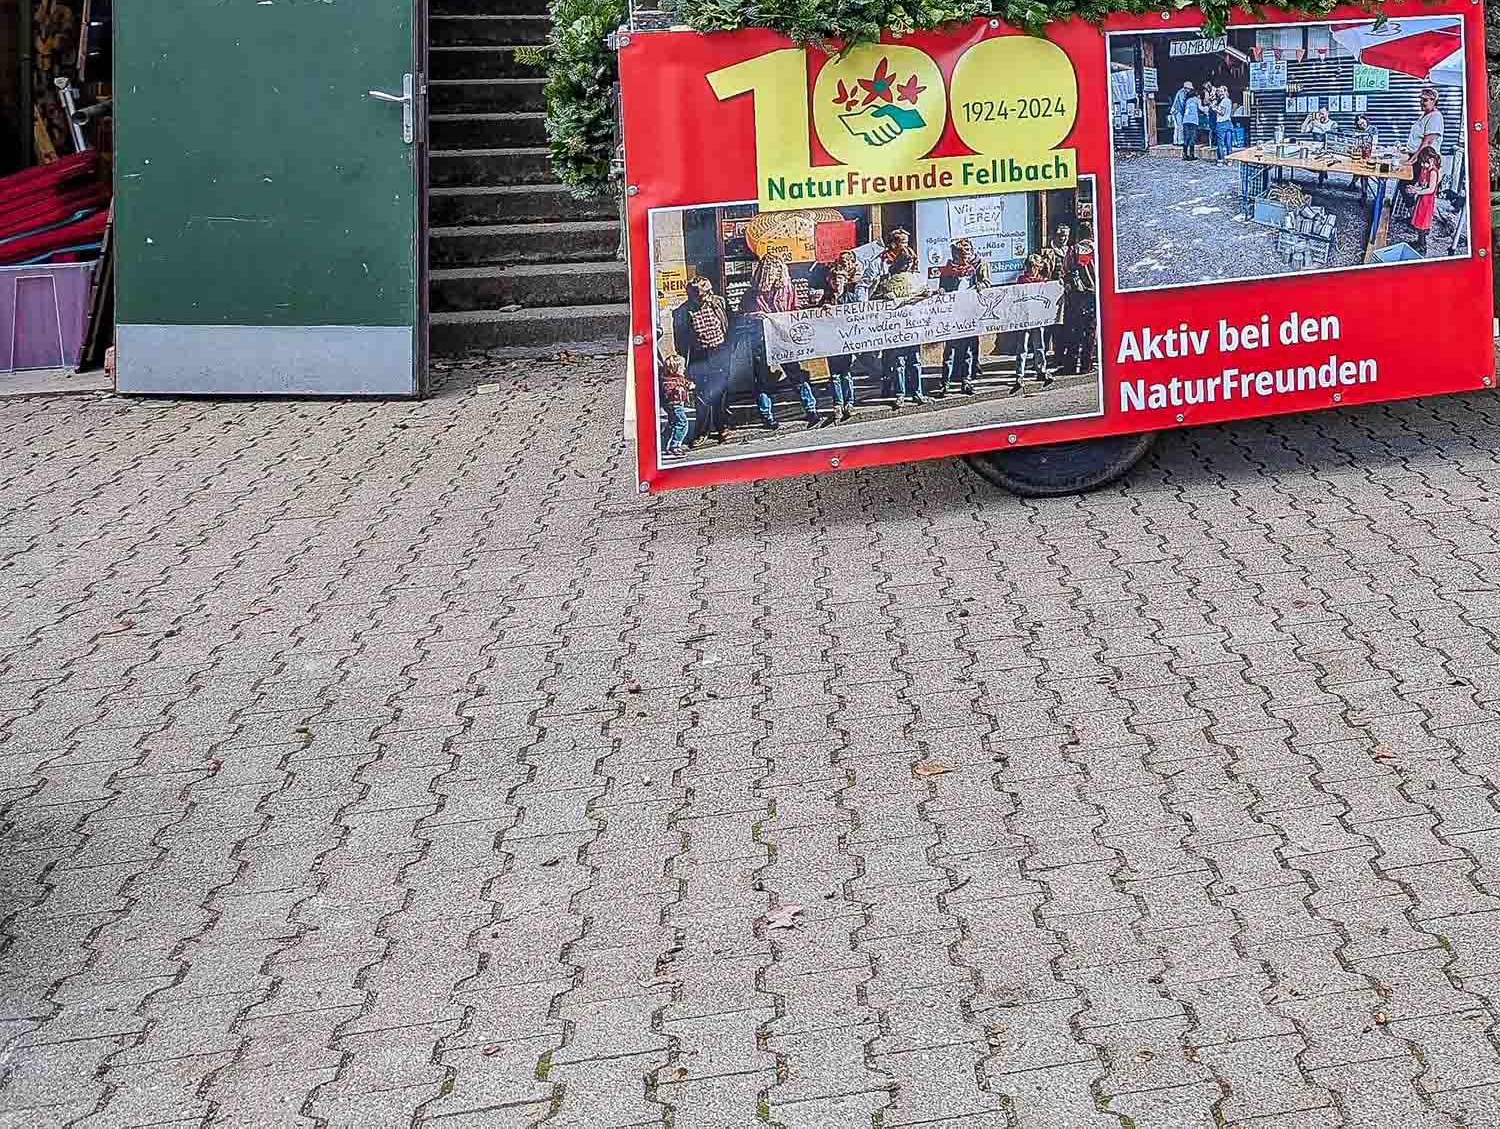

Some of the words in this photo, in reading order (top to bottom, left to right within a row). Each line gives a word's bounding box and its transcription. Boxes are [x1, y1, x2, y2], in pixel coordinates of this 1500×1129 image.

[1171, 37, 1226, 55] TOMBOLA
[962, 96, 1067, 123] 1924-2024
[767, 163, 953, 201] NaturFreunde
[962, 155, 1069, 186] Fellbach
[662, 280, 687, 292] NEIN
[838, 323, 864, 340] Wir
[868, 320, 901, 334] wollen
[841, 331, 920, 353] Atomraketen
[1115, 323, 1210, 365] Aktiv
[1218, 314, 1270, 352] bei
[1278, 310, 1341, 345] den
[1119, 354, 1379, 413] NaturFreunden
